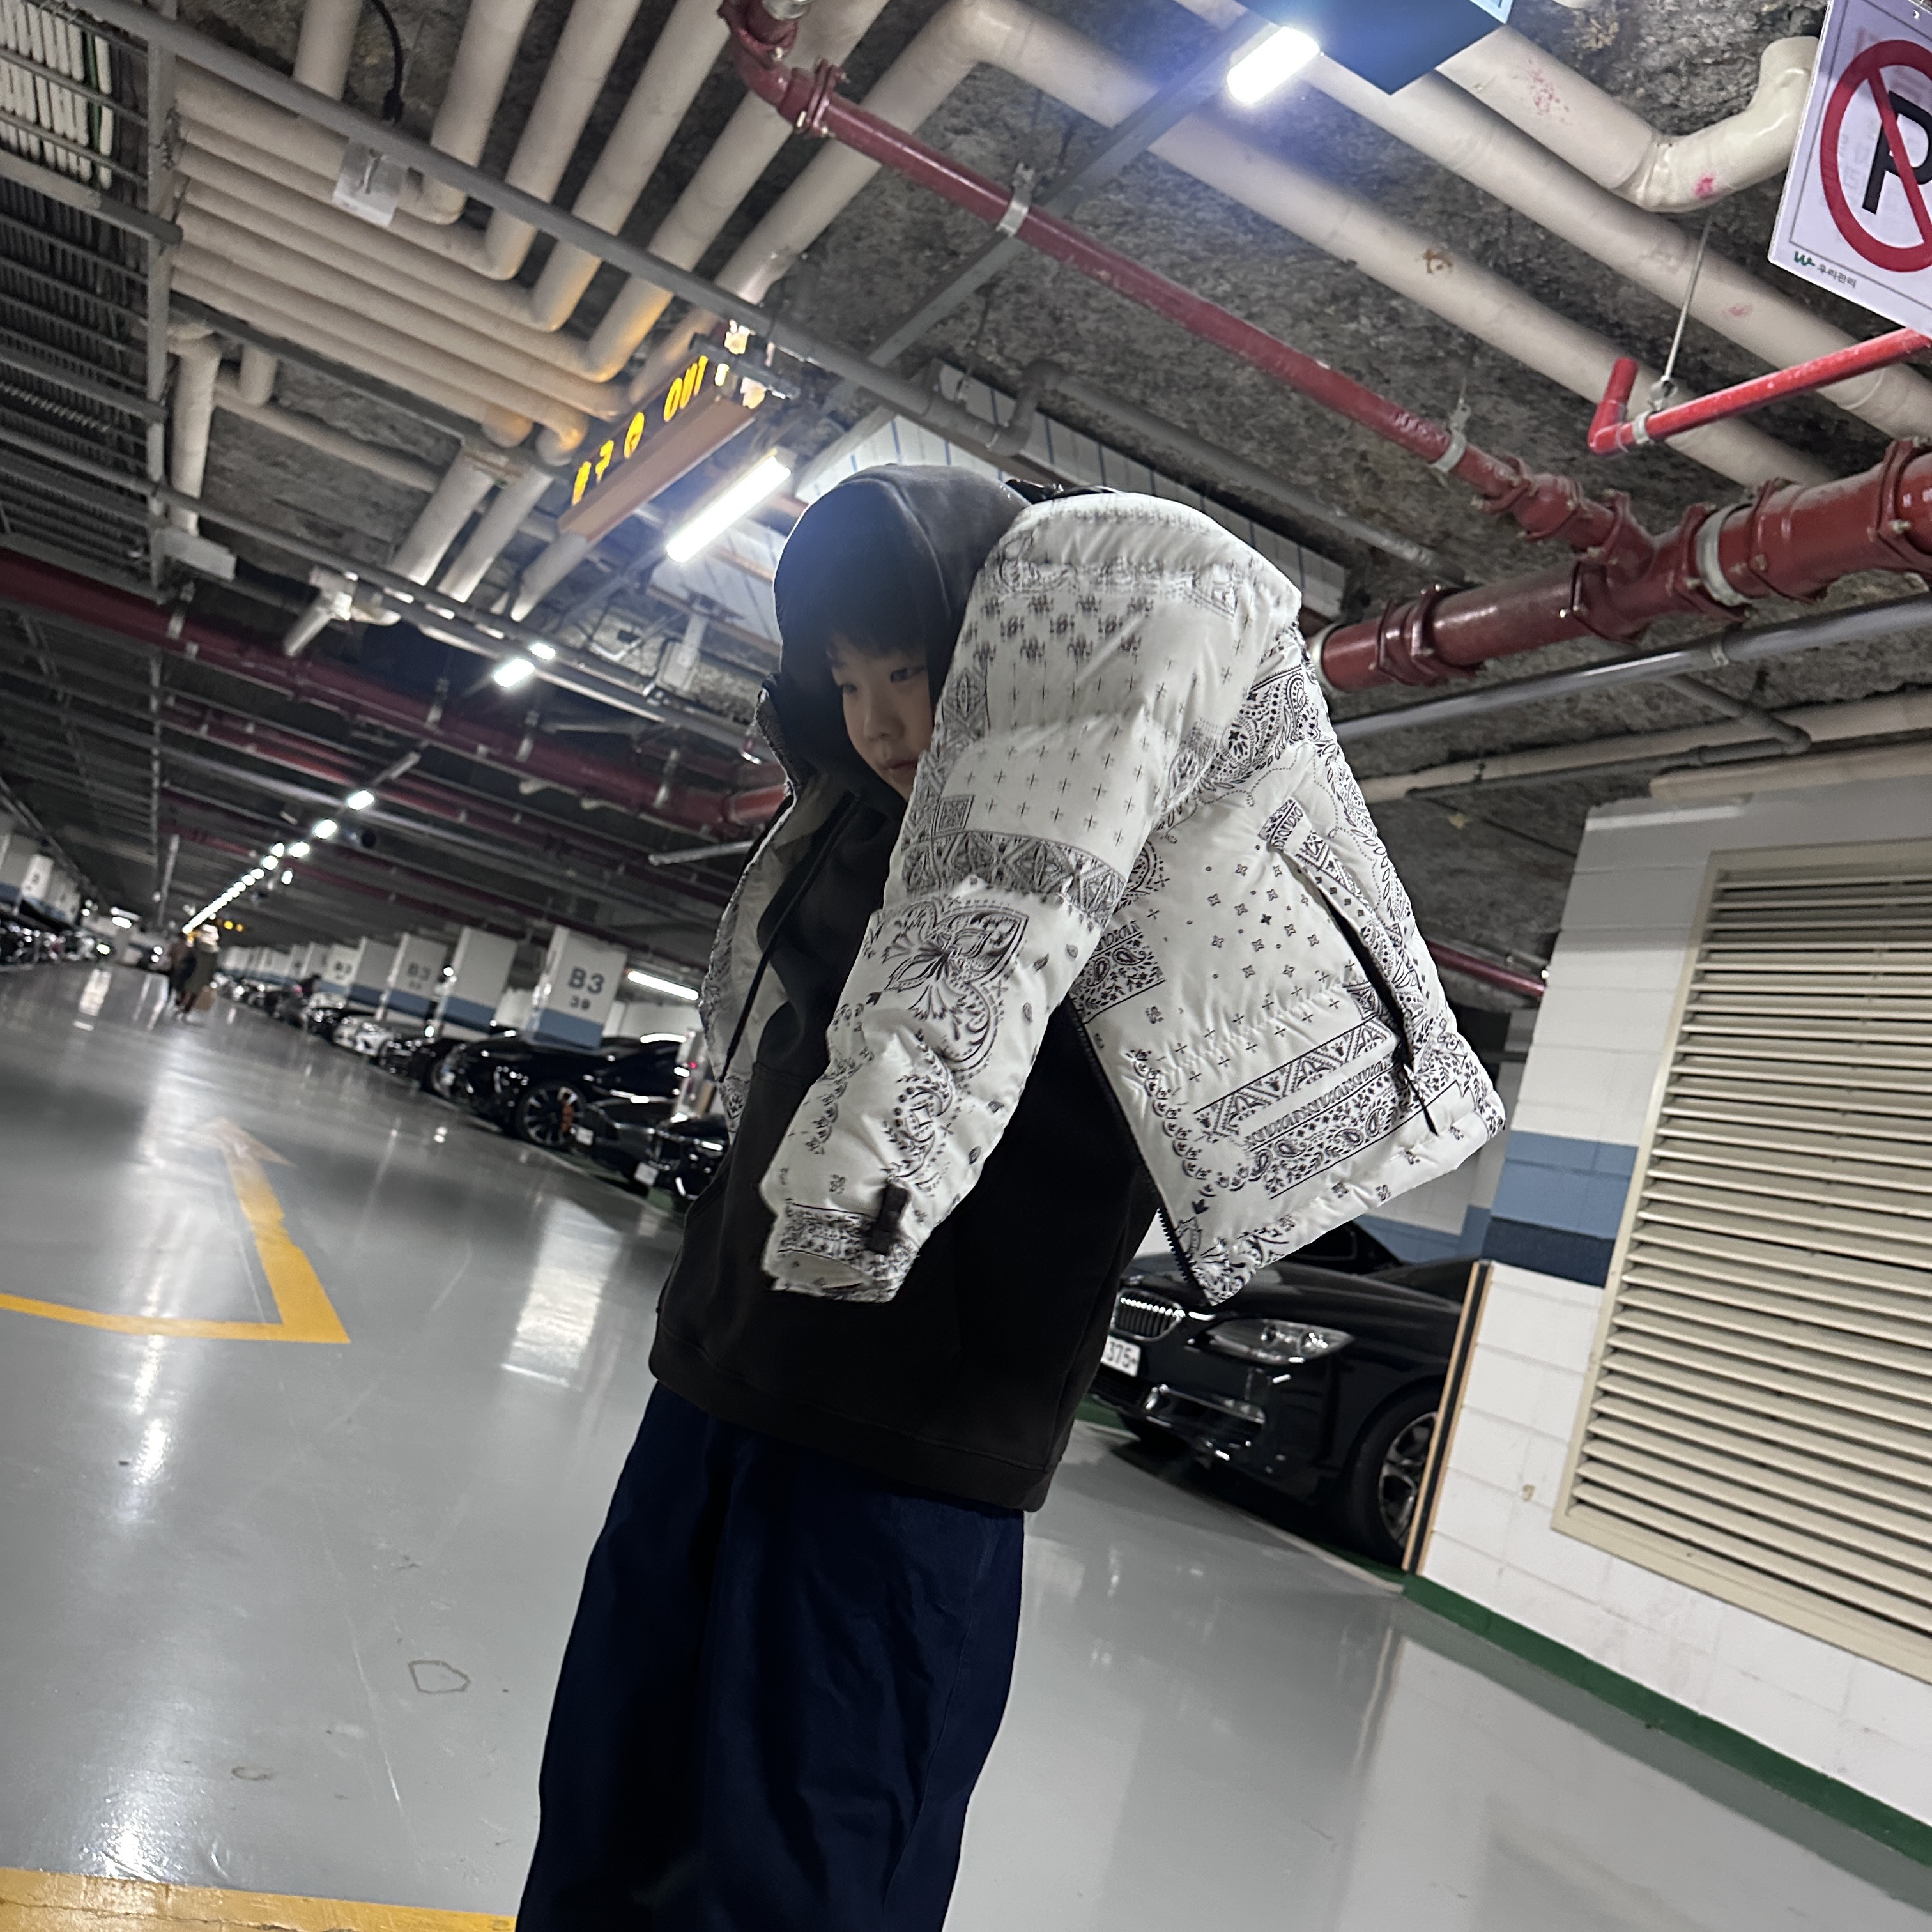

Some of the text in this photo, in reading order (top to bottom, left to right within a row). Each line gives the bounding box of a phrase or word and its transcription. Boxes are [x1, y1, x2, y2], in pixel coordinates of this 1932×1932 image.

[1862, 90, 1932, 214] P
[1819, 264, 1857, 288] 우리관리
[568, 966, 605, 994] B3
